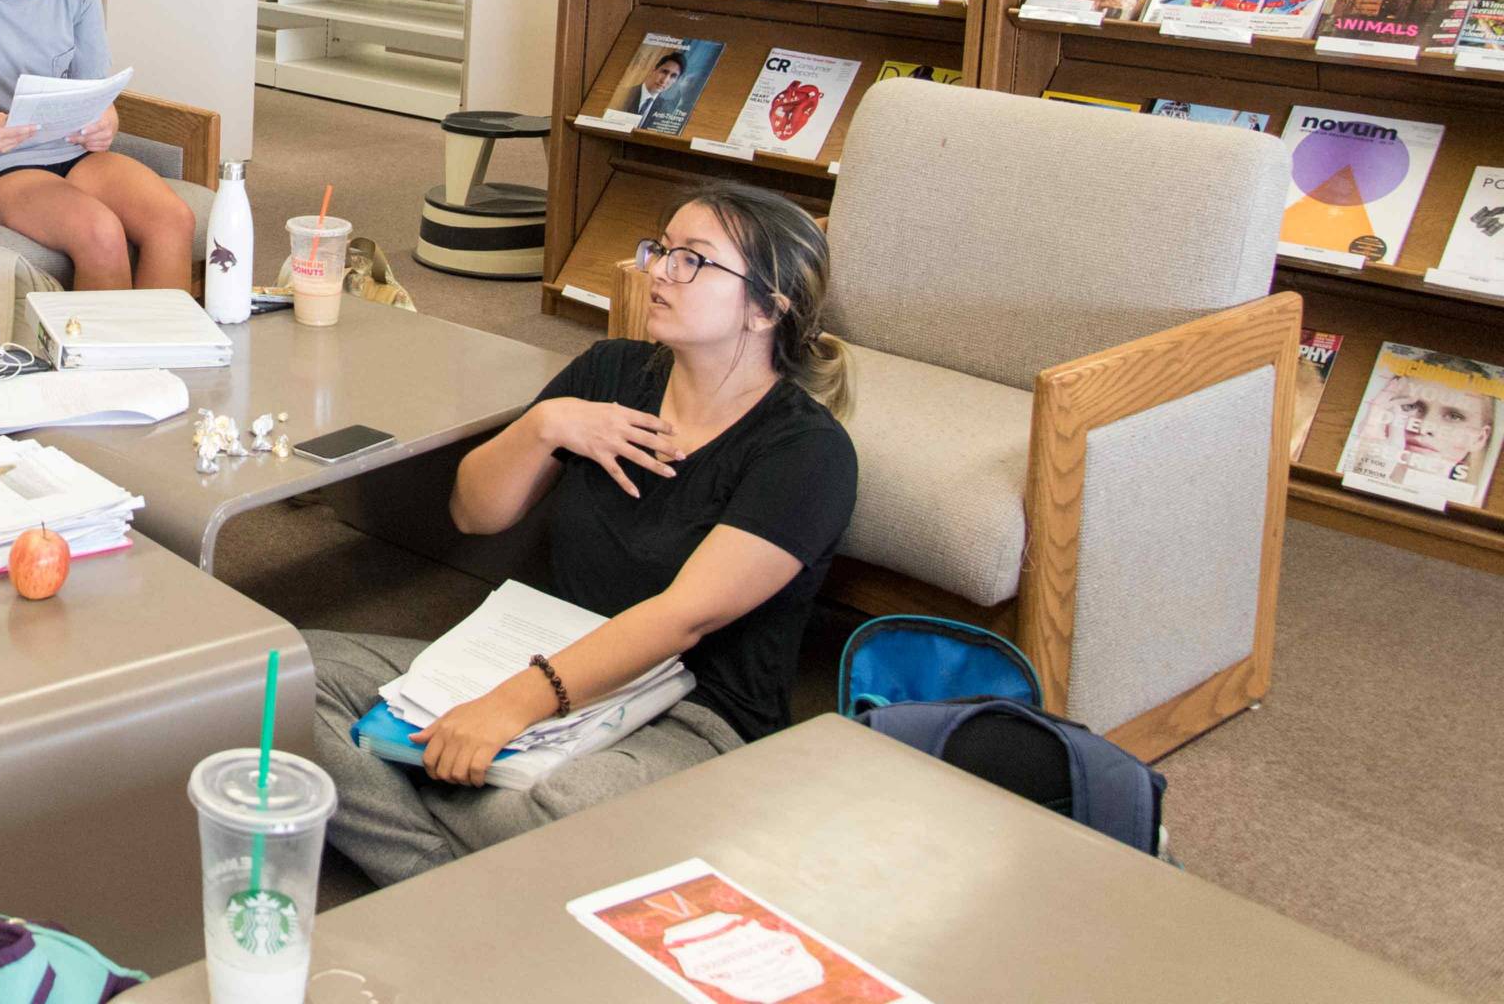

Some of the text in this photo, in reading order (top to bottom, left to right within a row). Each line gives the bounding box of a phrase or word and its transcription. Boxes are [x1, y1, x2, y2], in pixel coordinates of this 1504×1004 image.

[1334, 18, 1419, 37] ANIMALS
[765, 57, 791, 74] CR
[1301, 115, 1398, 142] novum
